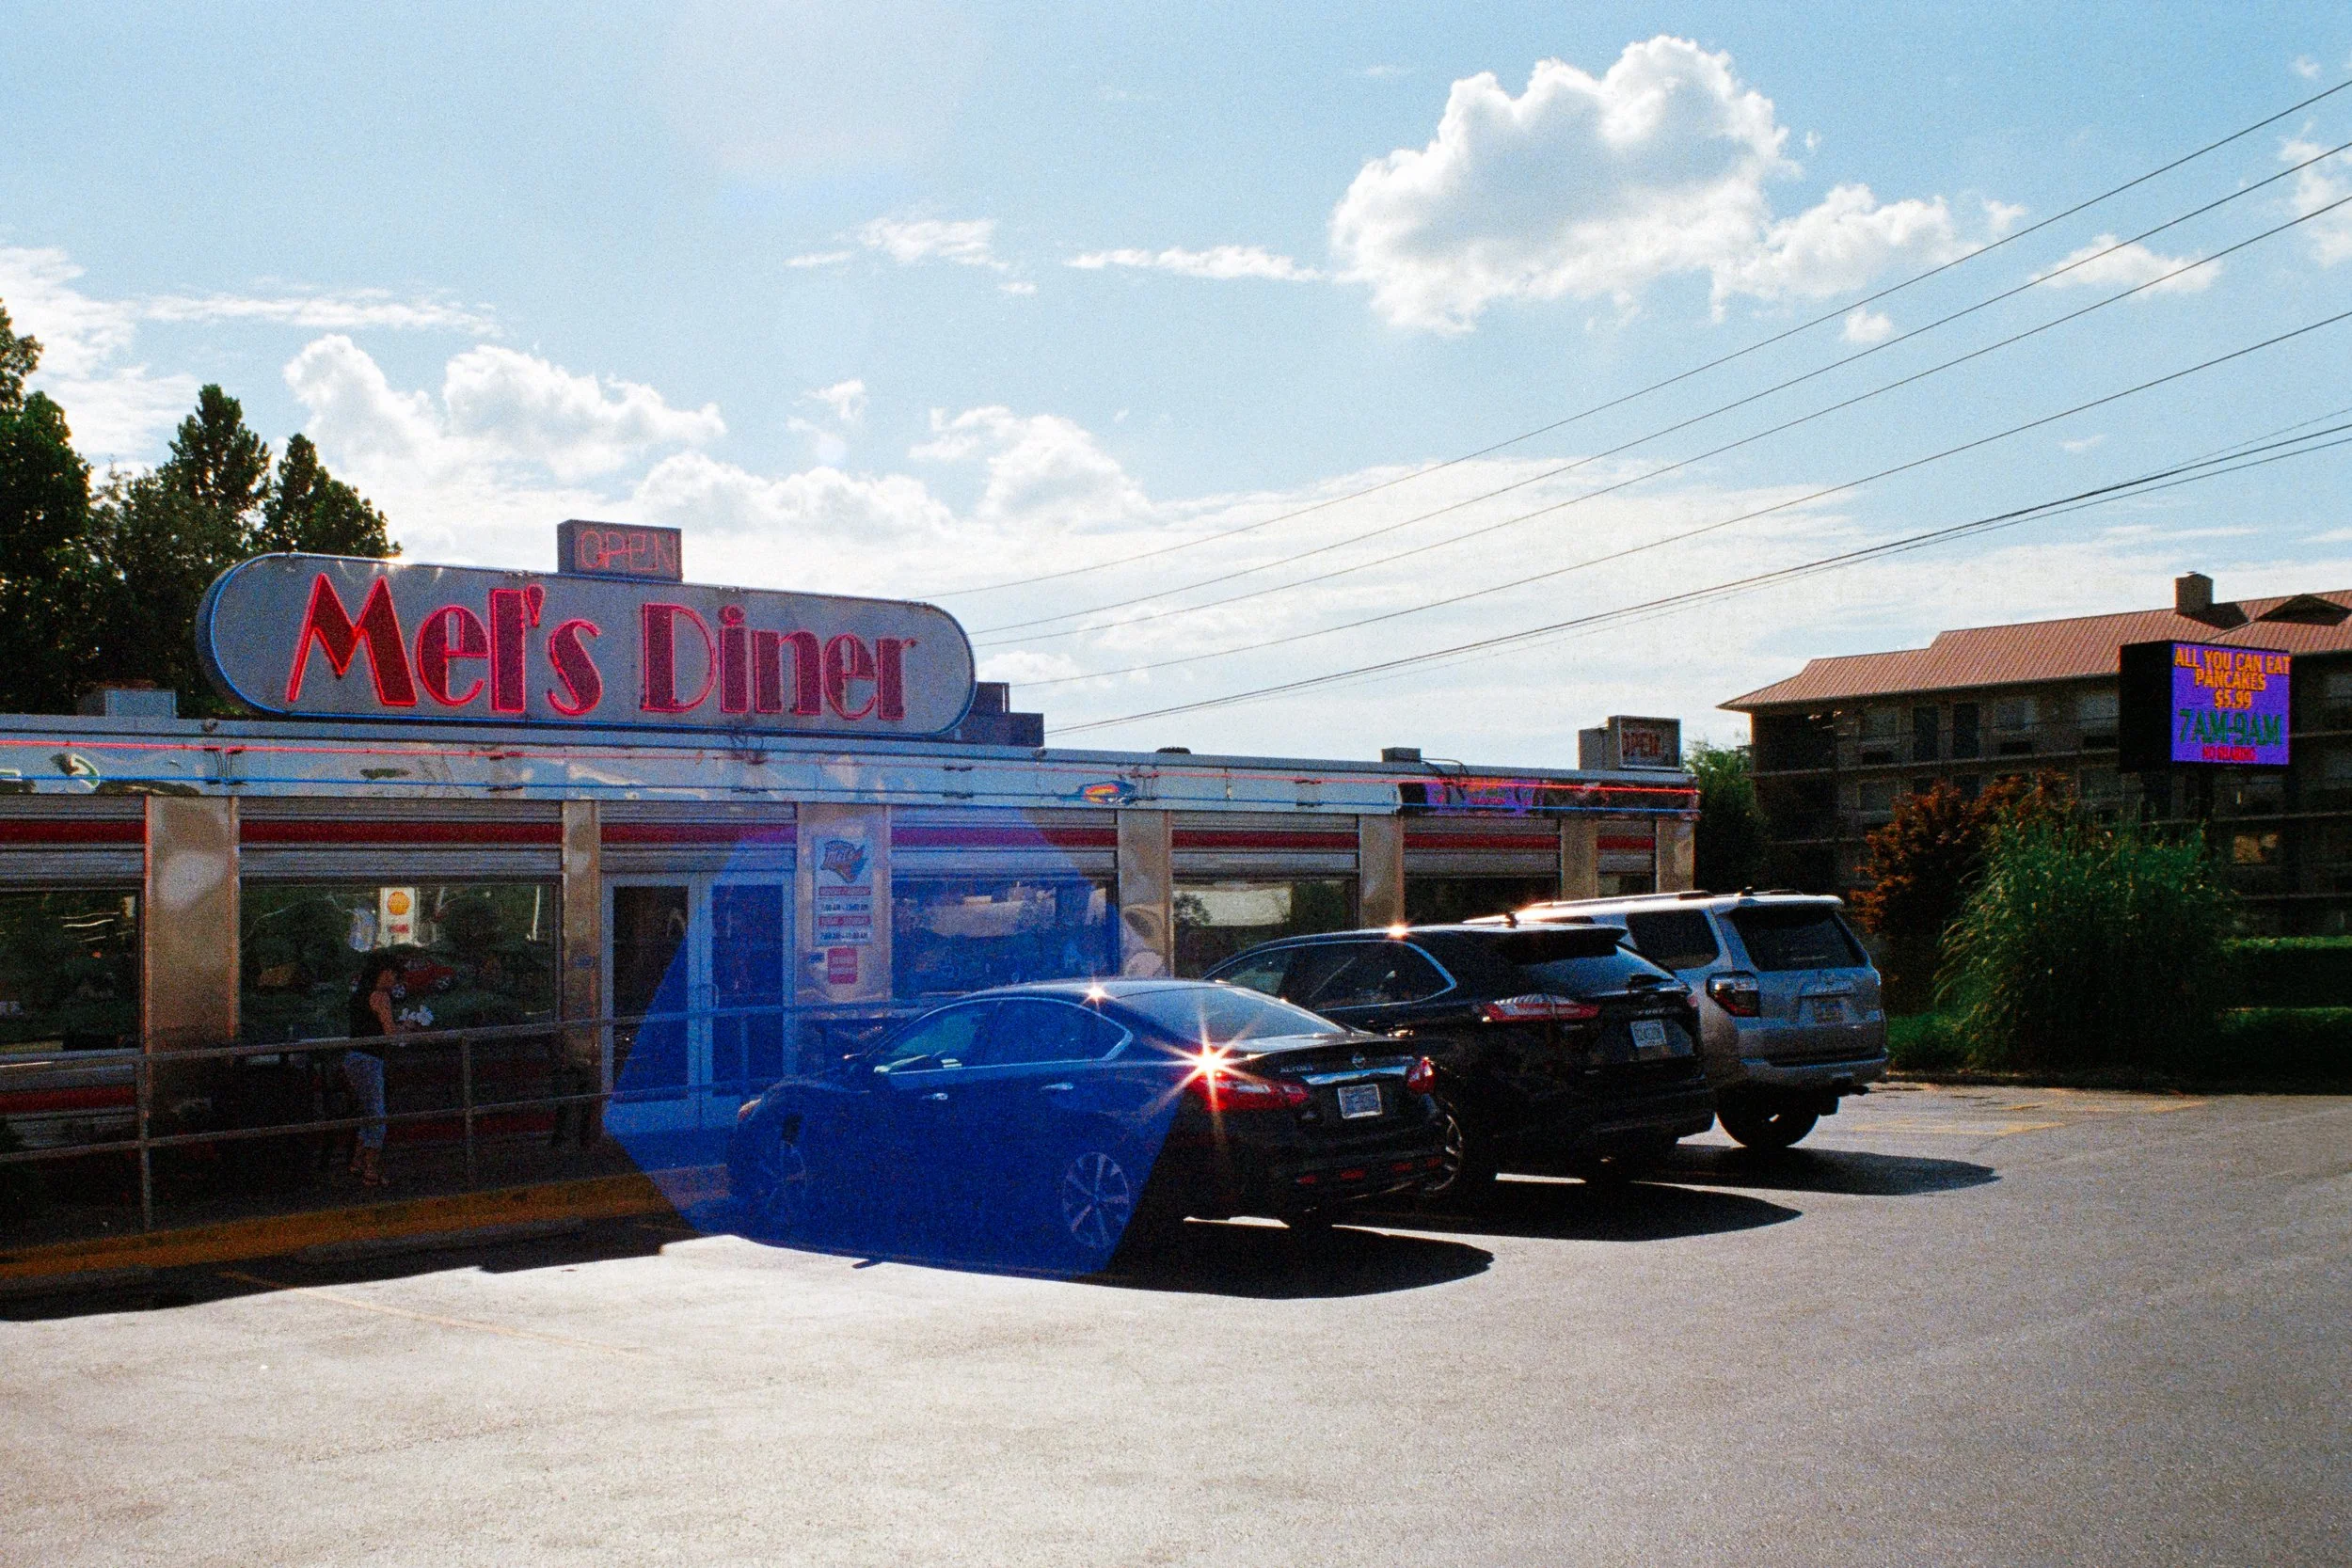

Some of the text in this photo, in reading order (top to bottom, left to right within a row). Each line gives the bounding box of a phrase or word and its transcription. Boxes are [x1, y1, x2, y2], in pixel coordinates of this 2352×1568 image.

[580, 529, 677, 573] OPEN
[286, 570, 918, 721] Mel's Diner
[2174, 647, 2291, 674] ALL YOU CAN EAT
[2195, 667, 2267, 691] PANCAKES
[2214, 689, 2252, 710] $5.99
[2178, 708, 2281, 746] 7AM-9AM
